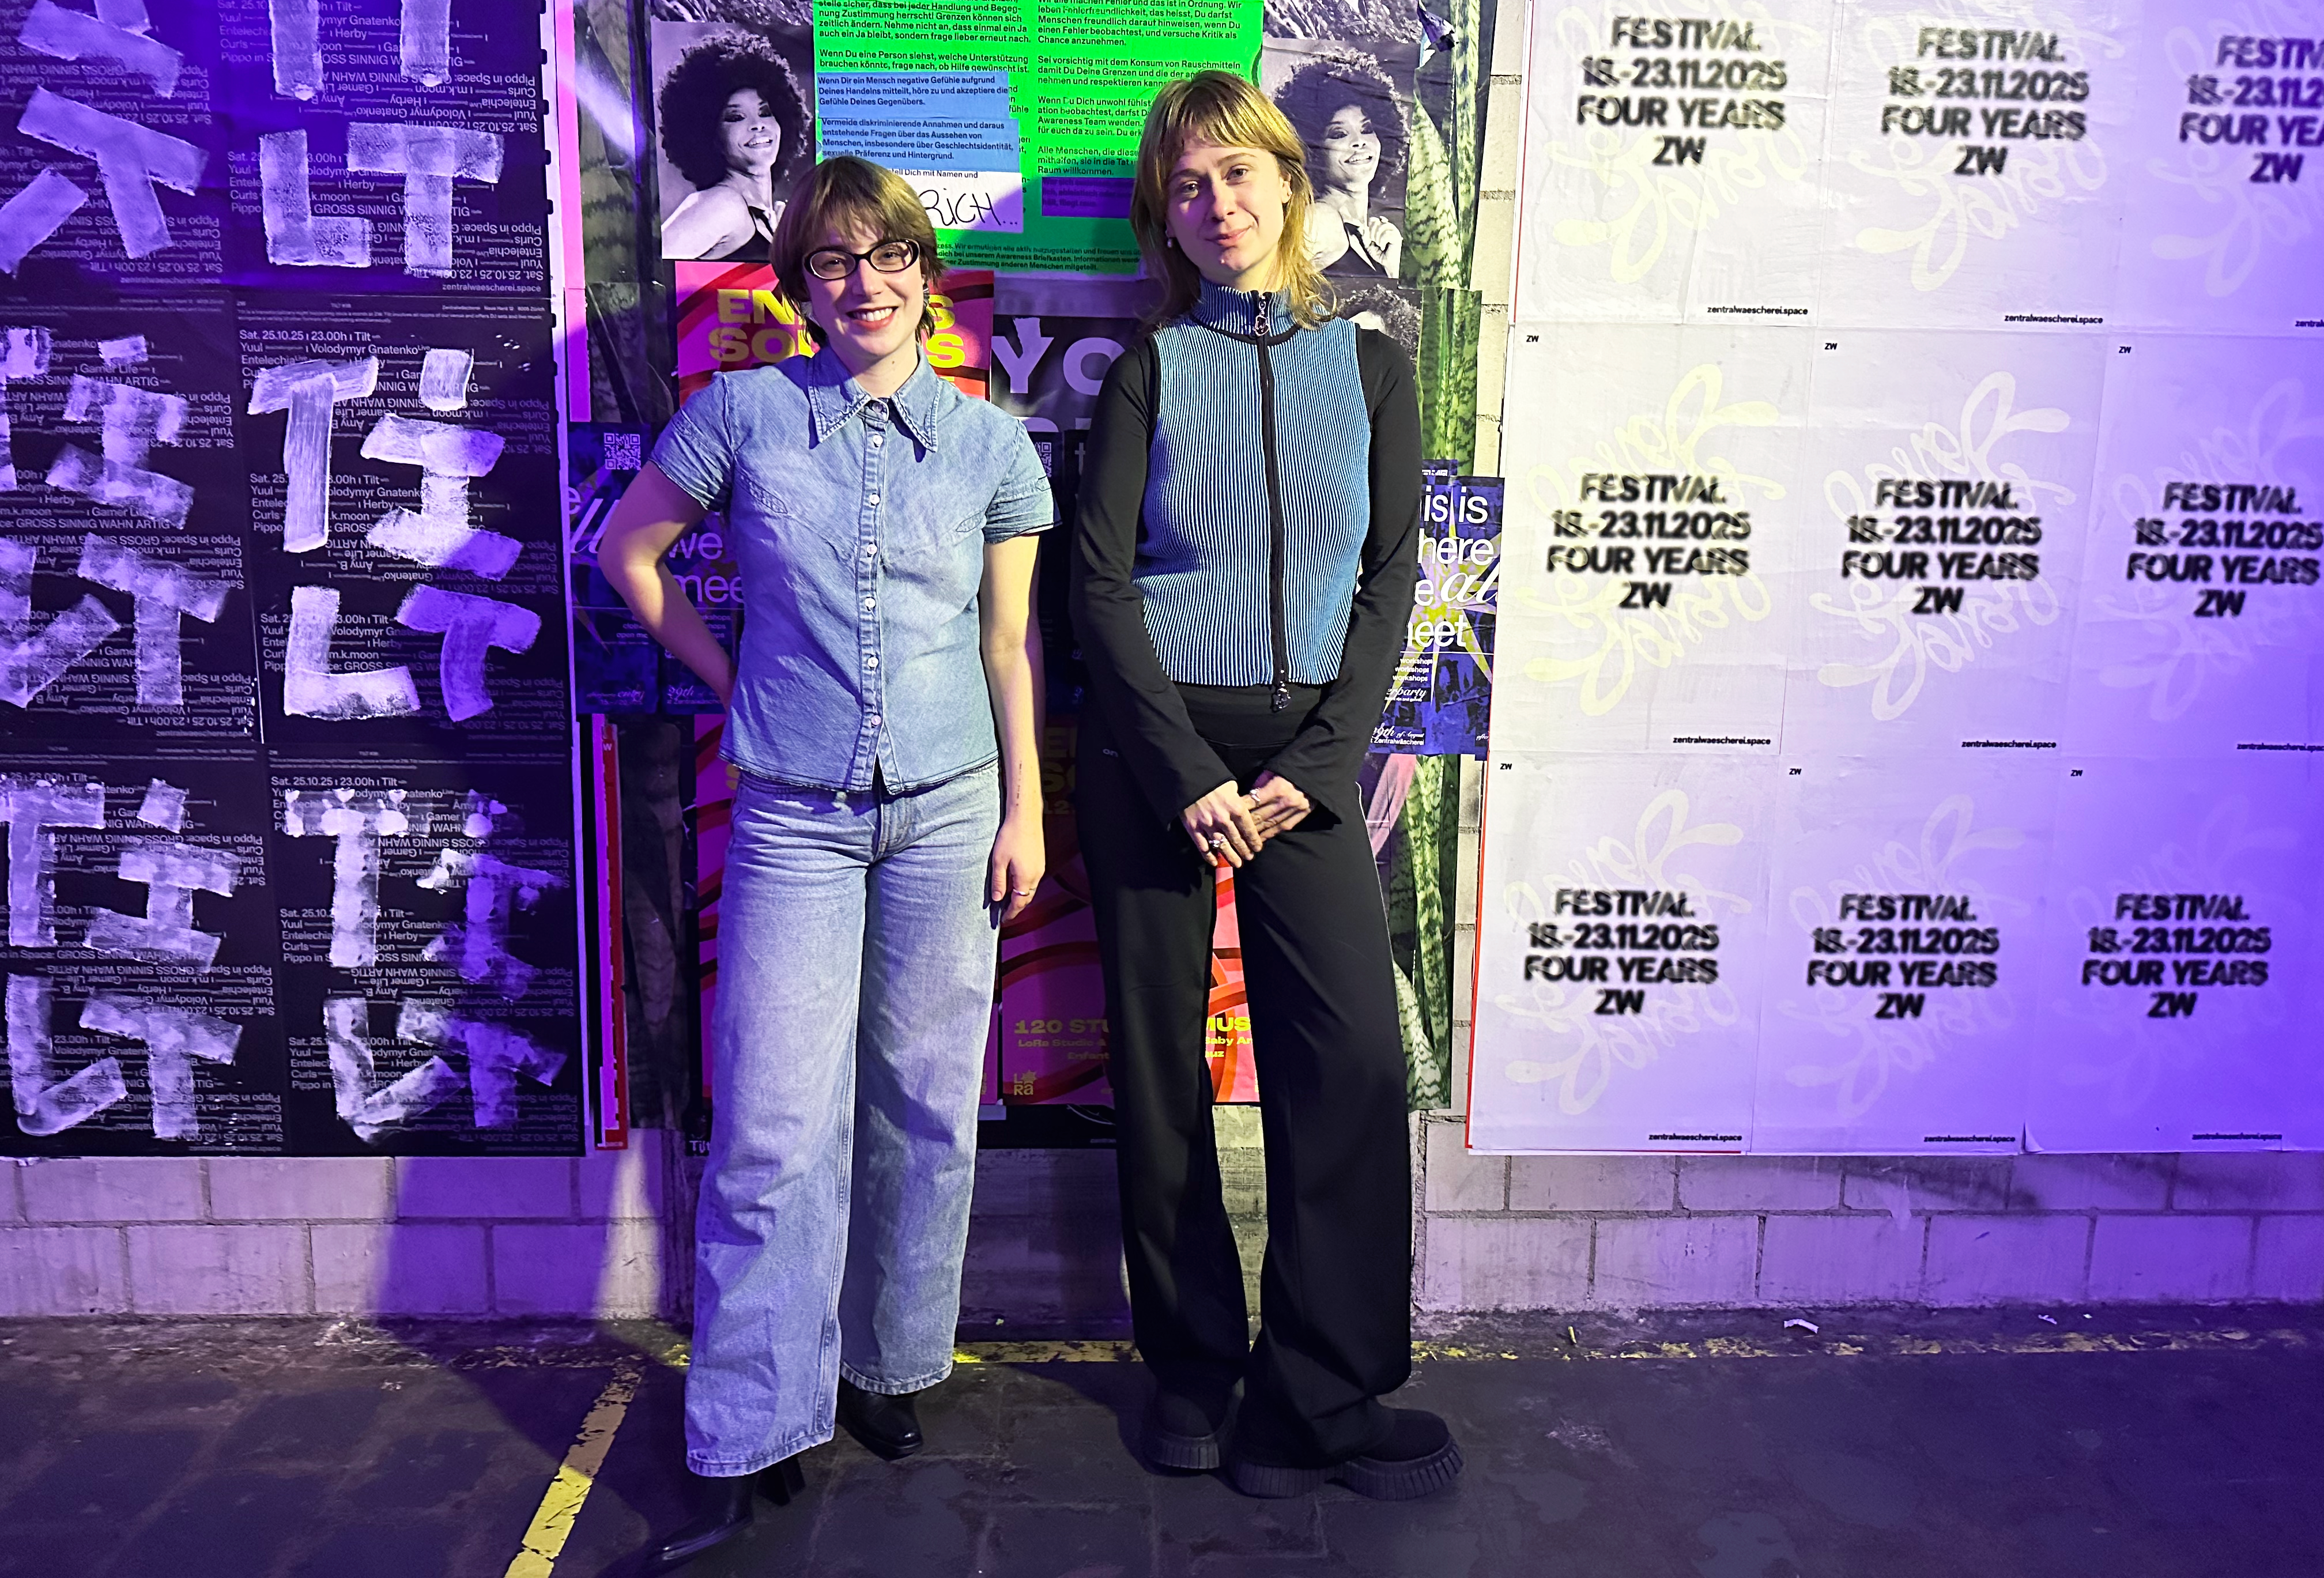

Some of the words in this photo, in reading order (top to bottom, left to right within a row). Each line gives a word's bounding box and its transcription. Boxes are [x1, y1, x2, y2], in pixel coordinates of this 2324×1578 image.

[851, 20, 882, 28] ändern.
[884, 21, 914, 29] Nehme
[952, 23, 972, 31] dass
[867, 31, 893, 39] bleibt,
[930, 32, 952, 41] frage
[1062, 26, 1089, 34] Fehler
[1090, 27, 1144, 36] beobachtest,
[1202, 30, 1223, 38] Kritik
[1612, 17, 1761, 51] FESTIVAL
[1918, 28, 2066, 63] FESTIVAL
[1052, 56, 1093, 66] vorsichtig
[1130, 58, 1163, 66] Konsum
[1182, 60, 1240, 69] Rauschmitteln
[508, 88, 535, 97] Curls
[897, 77, 929, 85] negative
[961, 76, 995, 85] aufgrund
[514, 111, 537, 120] Yuul
[1577, 95, 1668, 127] FOUR
[1678, 98, 1785, 130] YEARS
[1881, 105, 1972, 137] FOUR
[1981, 108, 2087, 141] YEARS
[516, 123, 537, 133] Sat.
[2180, 112, 2269, 145] FOUR
[1653, 136, 1706, 165] ZW
[1954, 145, 2008, 176] ZW
[2250, 153, 2304, 183] ZW
[1707, 305, 1808, 316] zentralwaescherei.space
[2005, 314, 2103, 324] zentralwaescherei.space
[239, 330, 260, 339] Sat.
[262, 330, 304, 340] 25.10.25
[311, 331, 347, 340] 23.00h
[354, 331, 371, 341] Tilt
[240, 343, 263, 352] Yuul
[311, 343, 366, 354] Volodymyr
[1582, 474, 1726, 504] FESTIVAL
[1876, 480, 2019, 510] FESTIVAL
[2164, 482, 2303, 515] FESTIVAL
[1458, 486, 1488, 523] is
[1417, 528, 1493, 565] here
[1547, 545, 1635, 574] FOUR
[1644, 547, 1749, 576] YEARS
[1842, 550, 1929, 579] FOUR
[1937, 552, 2039, 582] YEARS
[2127, 553, 2213, 583] FOUR
[2221, 556, 2321, 586] YEARS
[1619, 582, 1672, 609] ZW
[1912, 587, 1964, 614] ZW
[2194, 589, 2246, 617] ZW
[271, 776, 291, 785] Sat.
[293, 776, 333, 786] 25.10.25
[340, 777, 375, 786] 23.00h
[381, 777, 397, 786] Tilt
[1556, 889, 1695, 918] FESTIVAL
[1840, 894, 1977, 922] FESTIVAL
[2116, 894, 2250, 922] FESTIVAL
[1525, 956, 1609, 983] FOUR
[1617, 957, 1718, 984] YEARS
[1807, 960, 1892, 987] FOUR
[1899, 961, 1998, 987] YEARS
[2082, 960, 2165, 986] FOUR
[2172, 960, 2269, 987] YEARS
[1594, 989, 1645, 1015] ZW
[1875, 993, 1925, 1020] ZW
[2147, 992, 2198, 1018] ZW
[1014, 1020, 1063, 1034] 120
